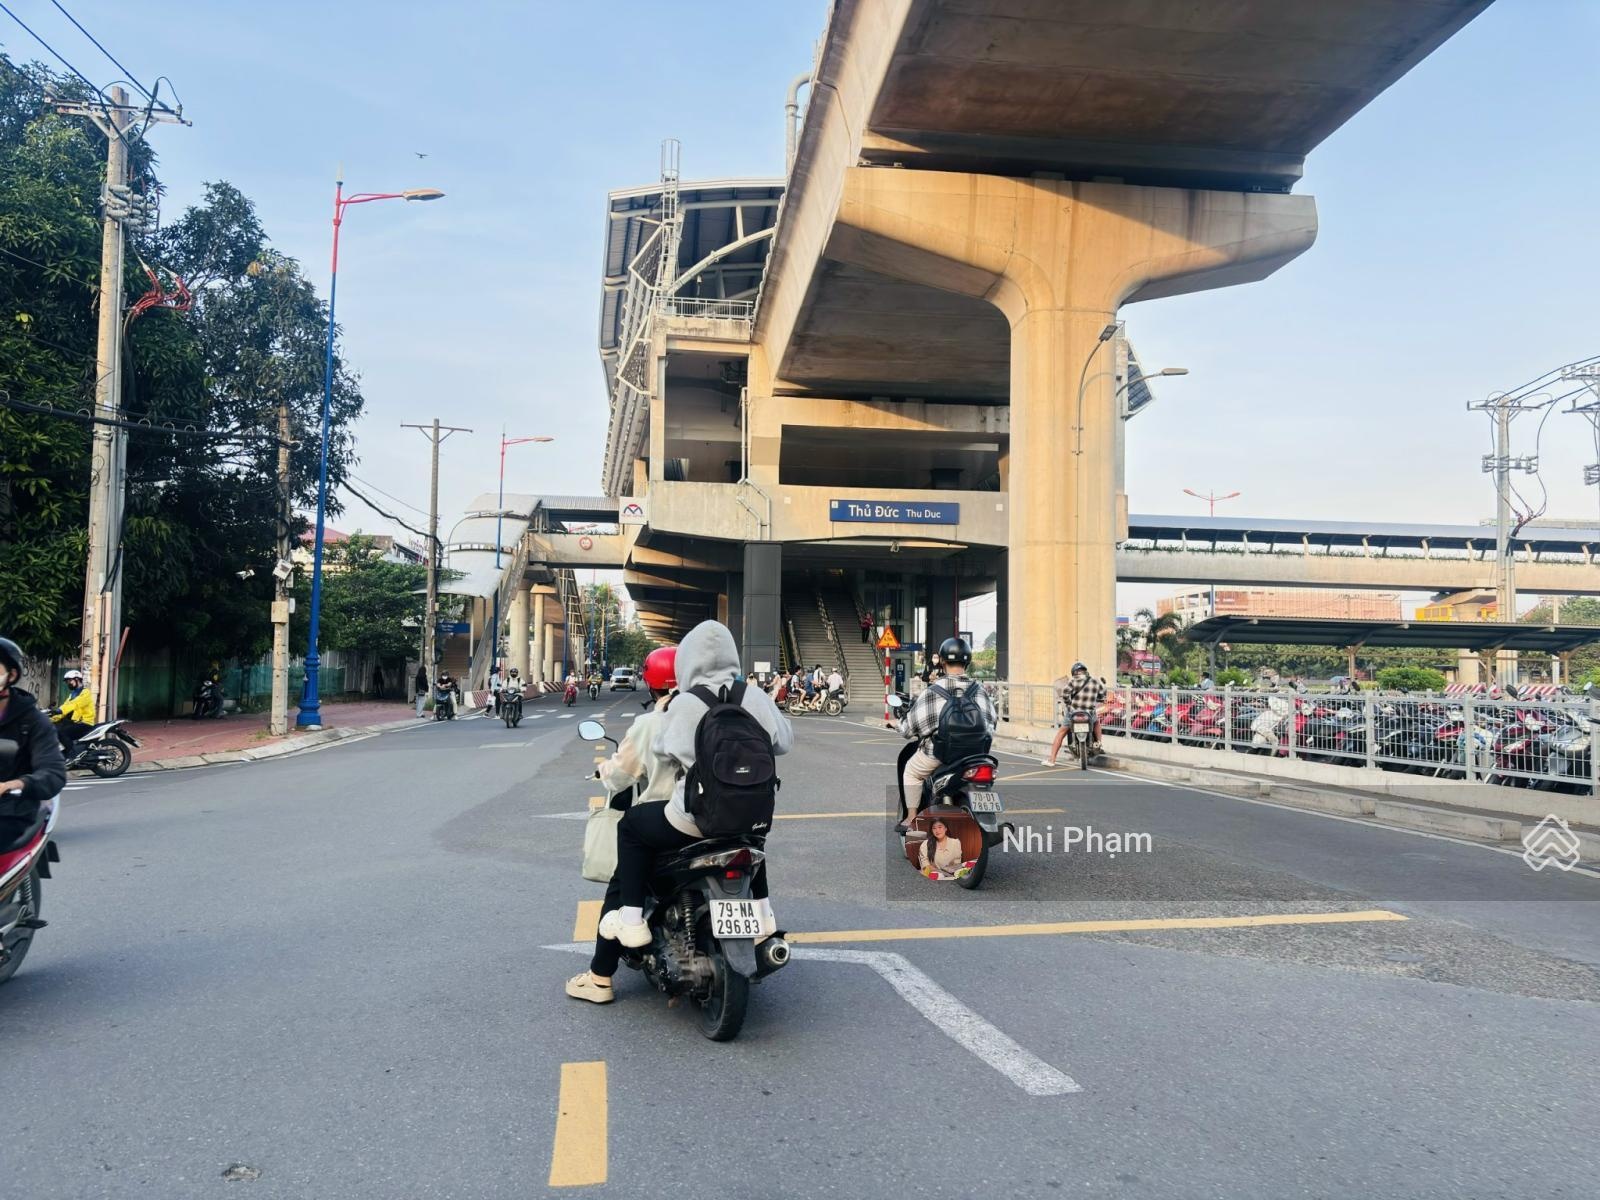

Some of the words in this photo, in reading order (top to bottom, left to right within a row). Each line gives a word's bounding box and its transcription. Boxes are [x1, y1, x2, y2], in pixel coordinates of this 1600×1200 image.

[848, 504, 871, 517] Thủ
[875, 505, 899, 518] Đức
[906, 509, 922, 518] Thu
[924, 509, 941, 518] Duc
[718, 902, 754, 917] 79-NA
[717, 919, 759, 935] 296.83
